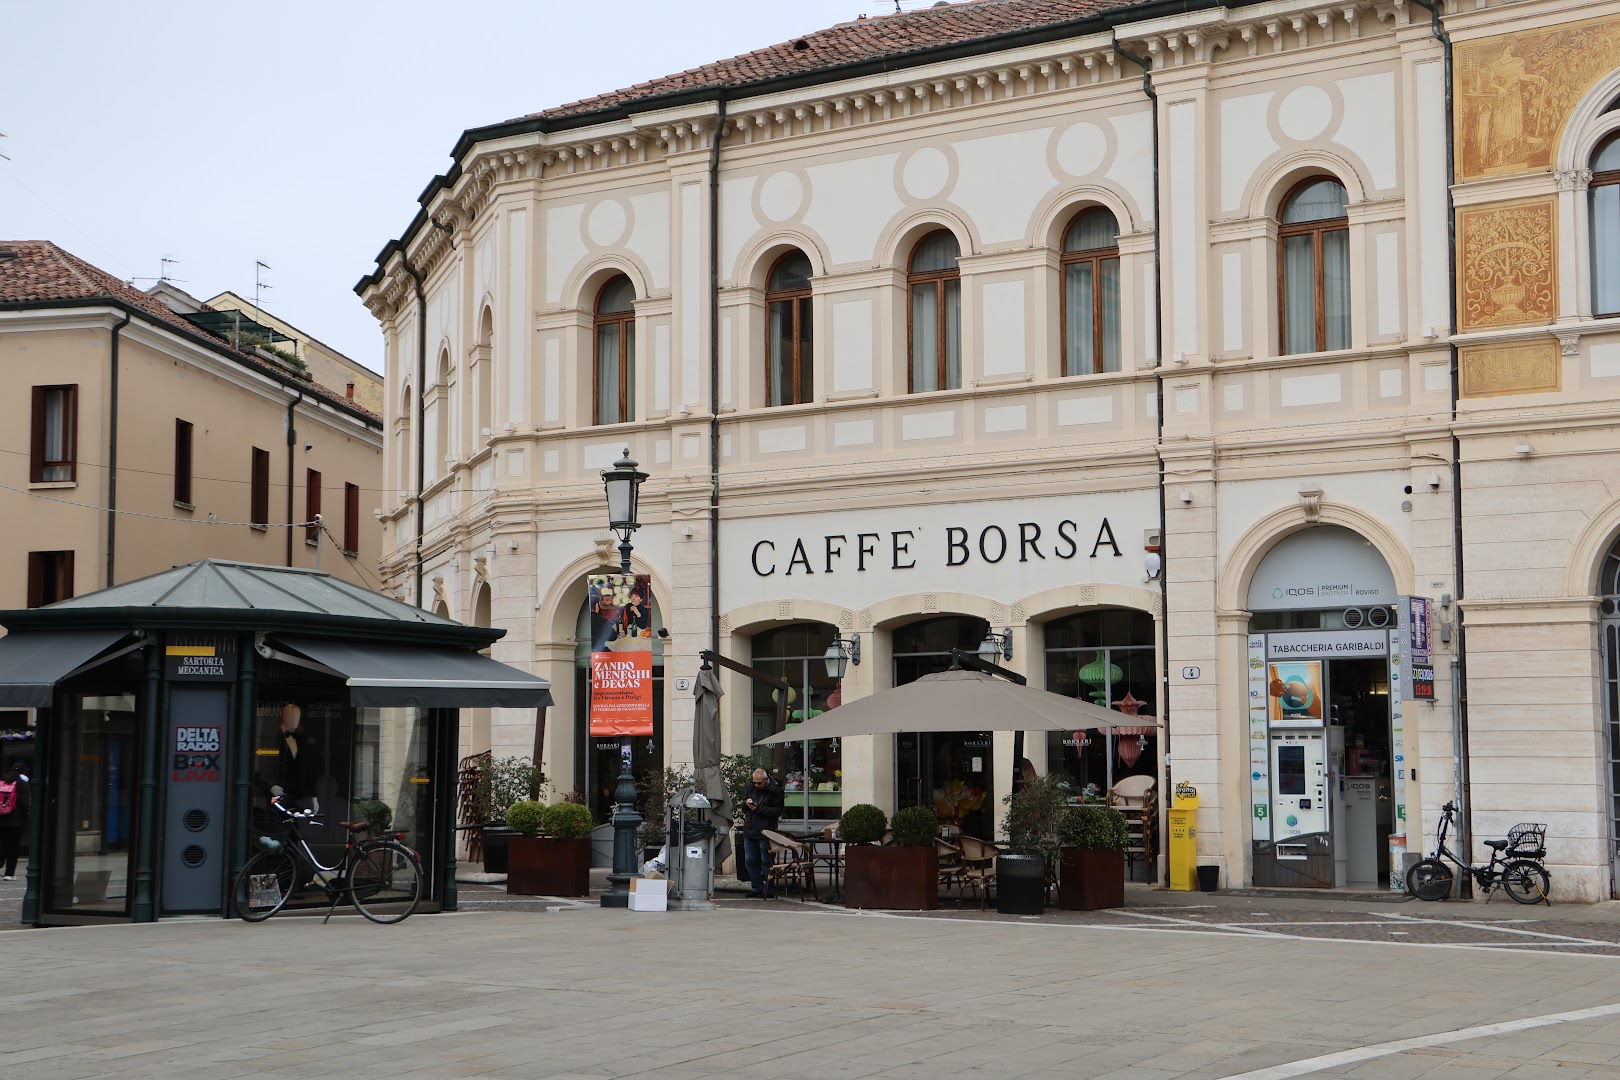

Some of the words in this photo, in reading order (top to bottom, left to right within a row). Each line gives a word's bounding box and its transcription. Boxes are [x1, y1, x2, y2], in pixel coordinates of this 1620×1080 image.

[946, 517, 1123, 566] BORSA
[1285, 588, 1314, 597] IQOS
[1272, 643, 1334, 653] TABACCHERIA
[1335, 642, 1384, 651] GARIBALDI
[183, 656, 225, 666] SARTORIA
[594, 661, 635, 672] ZANDO
[177, 665, 224, 675] MECCANICA
[595, 669, 651, 680] MENEGHI
[601, 679, 641, 689] DEGAS
[176, 727, 220, 742] DELTA
[176, 741, 220, 752] RADIO
[174, 754, 221, 771] BOX
[173, 770, 221, 783] LIVE
[1257, 808, 1264, 817] 5
